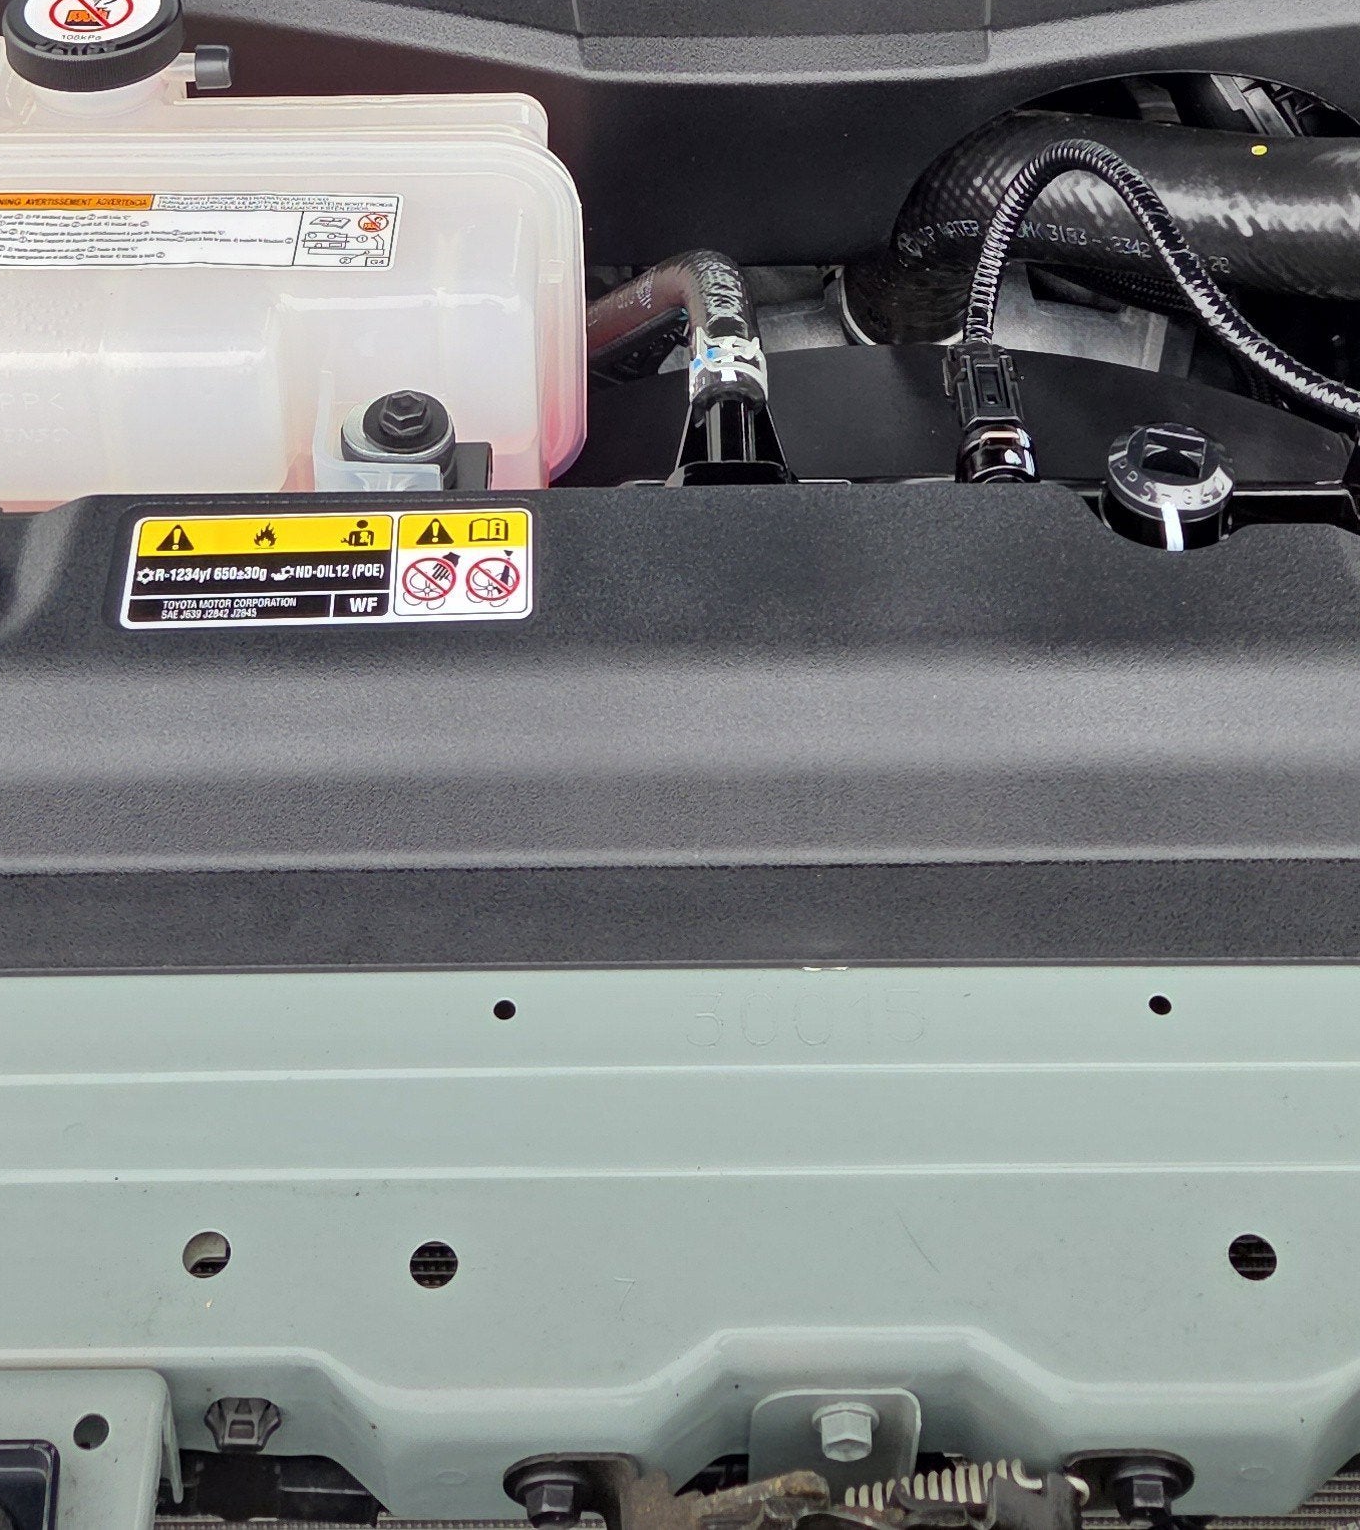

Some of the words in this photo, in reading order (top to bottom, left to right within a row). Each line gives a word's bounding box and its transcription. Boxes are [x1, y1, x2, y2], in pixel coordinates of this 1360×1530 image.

[26, 198, 92, 206] AVERTISSEMENT
[95, 198, 148, 207] ADVERTENCIA
[155, 566, 211, 582] R-1234yf
[214, 565, 267, 581] 650±30g
[295, 564, 349, 579] ND-OIL12
[352, 563, 384, 580] (POE)
[162, 600, 198, 609] TOYOTA
[199, 599, 231, 608] MOTOR
[233, 597, 297, 608] CORPORATION
[349, 597, 378, 613] WF
[161, 610, 178, 619] SAE
